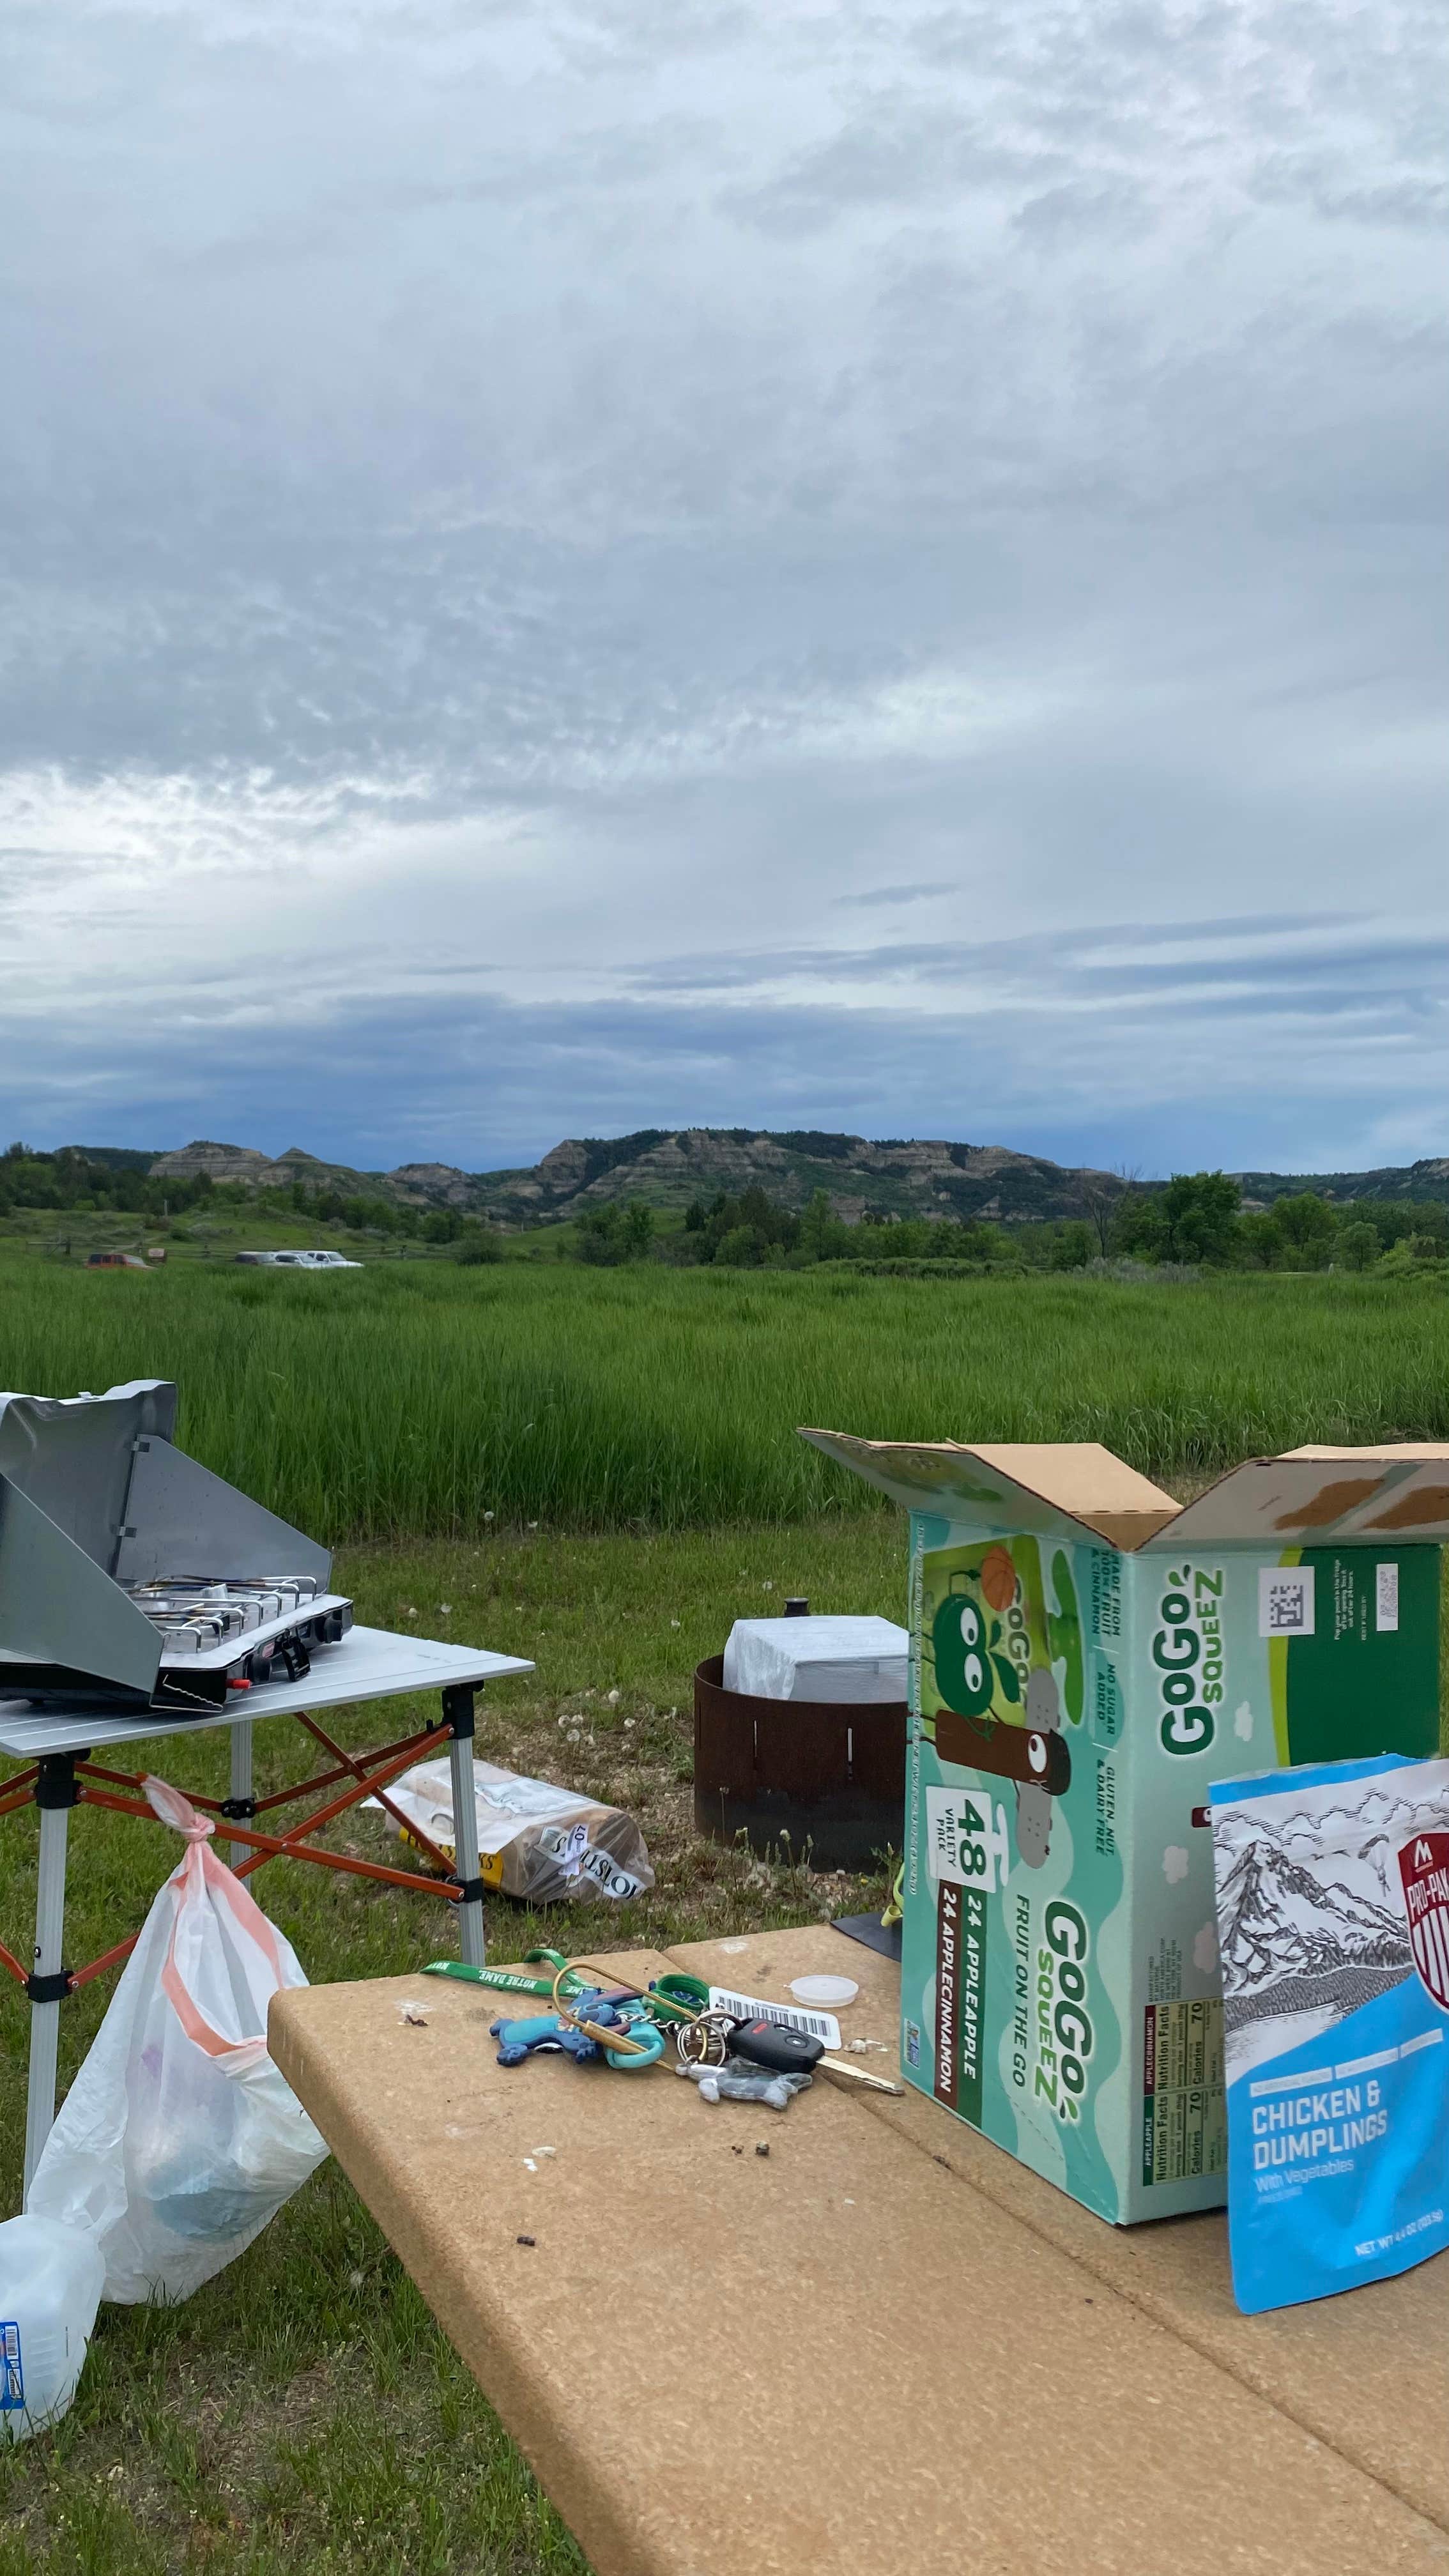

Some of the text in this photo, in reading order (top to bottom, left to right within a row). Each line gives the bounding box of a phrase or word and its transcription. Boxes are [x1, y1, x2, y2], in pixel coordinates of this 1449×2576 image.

[1091, 1563, 1101, 1635] CINNAMON
[1101, 1591, 1112, 1637] FRUIT
[1111, 1553, 1121, 1637] MADE FROM
[1096, 1672, 1107, 1721] ADDED
[1106, 1663, 1116, 1735] NO SUGAR
[1096, 1774, 1105, 1816] DAIRY
[1105, 1767, 1115, 1824] GLUTEN,
[935, 1818, 946, 1851] PACK
[945, 1808, 957, 1867] VARIETY
[958, 1798, 986, 1876] 48
[1096, 1819, 1105, 1856] FREE
[507, 1974, 538, 1989] NOTRE
[939, 1889, 957, 2093] 24 APPLECINNAMON
[963, 1894, 983, 2080] 24 APPLEAPPLE
[1013, 1894, 1030, 2088] FRUIT ON THE GO
[1158, 2005, 1169, 2037] Facts
[1191, 2002, 1203, 2085] Calories 70
[1146, 2017, 1154, 2085] APPLECINNAMON
[1157, 2041, 1169, 2090] Nutrition
[1190, 2092, 1201, 2114] 70
[1252, 2085, 1361, 2135] CHICKEN
[1366, 2080, 1382, 2107] &
[1156, 2096, 1168, 2181] Nutrition Facts
[1189, 2130, 1201, 2175] Calories
[1253, 2109, 1388, 2170] DUMPLINGS
[1255, 2158, 1354, 2193] With Vegetables
[1354, 2240, 1376, 2256] NET
[1377, 2235, 1393, 2250] WT
